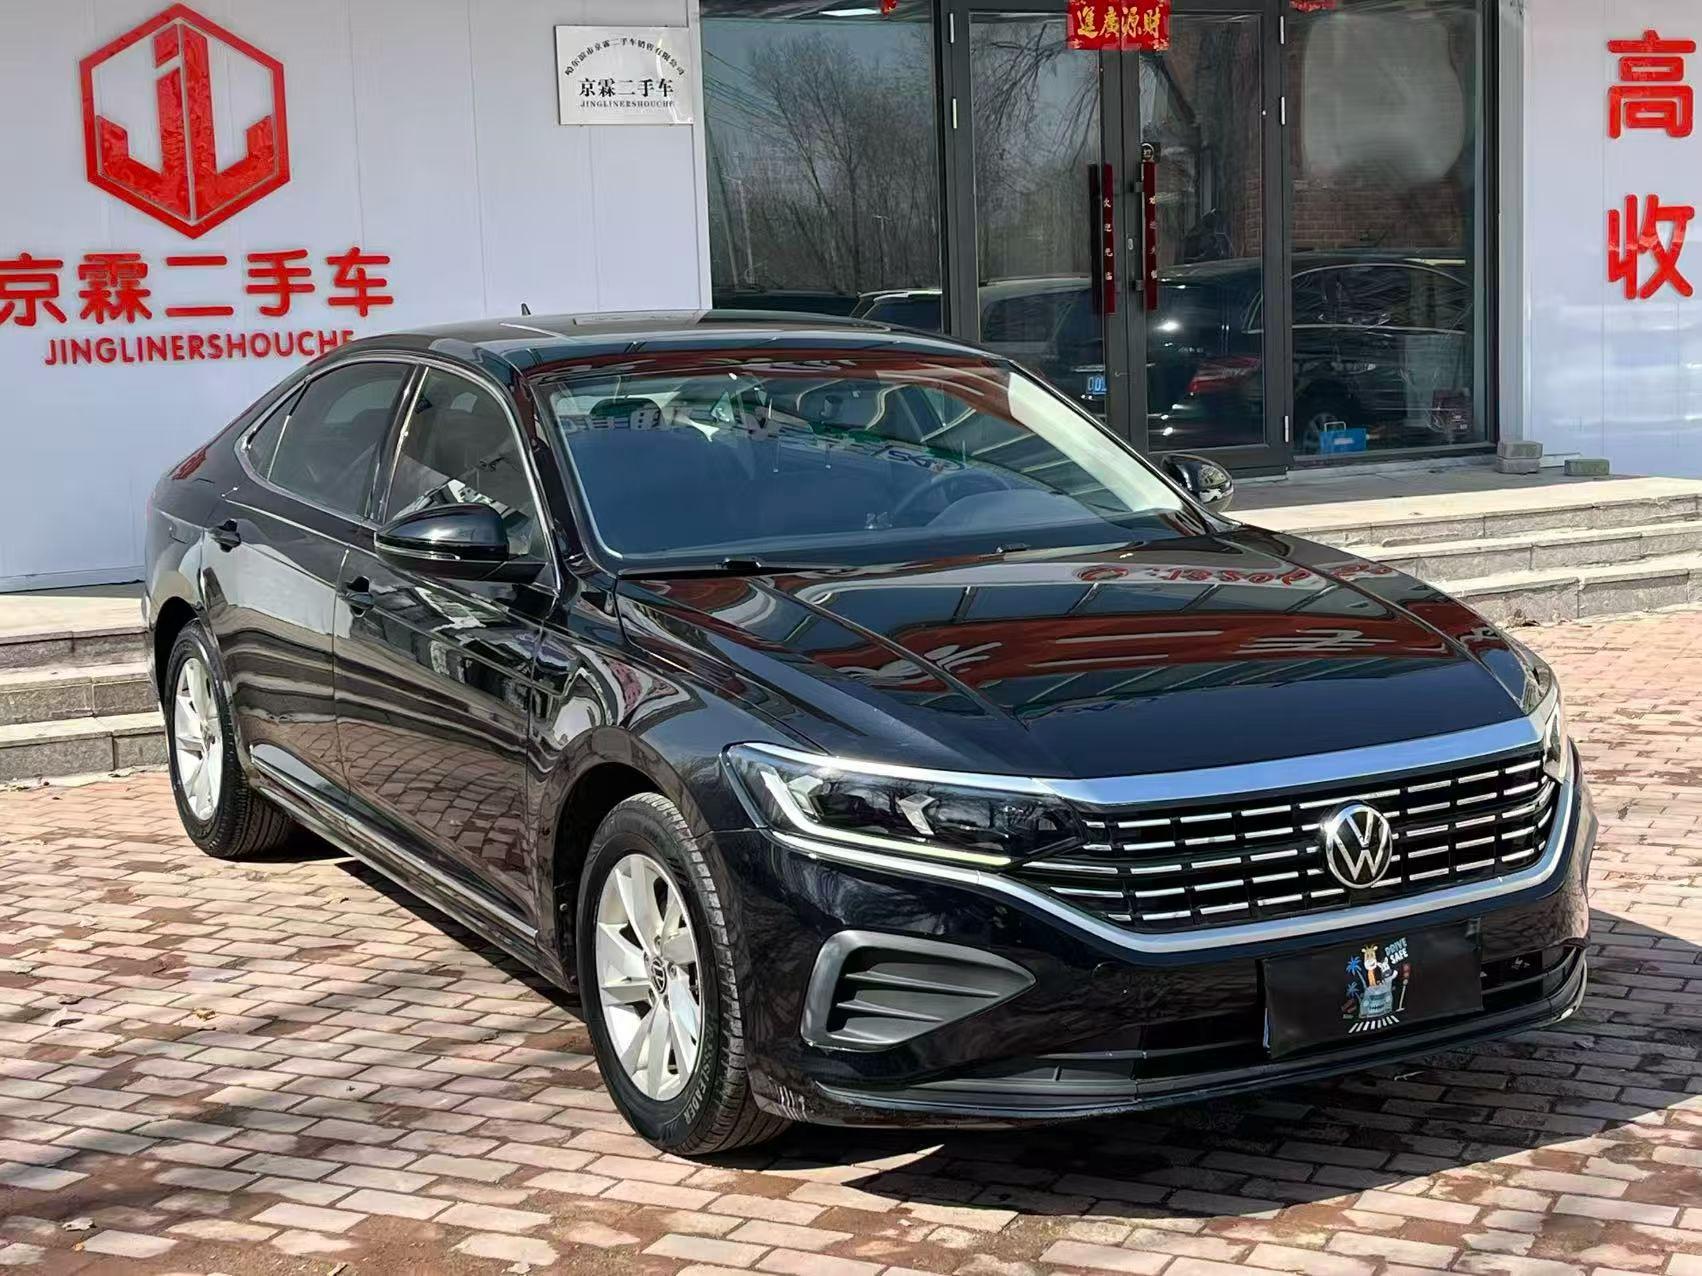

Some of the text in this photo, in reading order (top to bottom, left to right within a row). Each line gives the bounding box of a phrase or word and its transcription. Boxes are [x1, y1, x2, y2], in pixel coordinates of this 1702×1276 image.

[579, 78, 674, 98] 京霖二手车
[0, 246, 394, 327] 京霖二手车
[1389, 948, 1408, 964] SAFE
